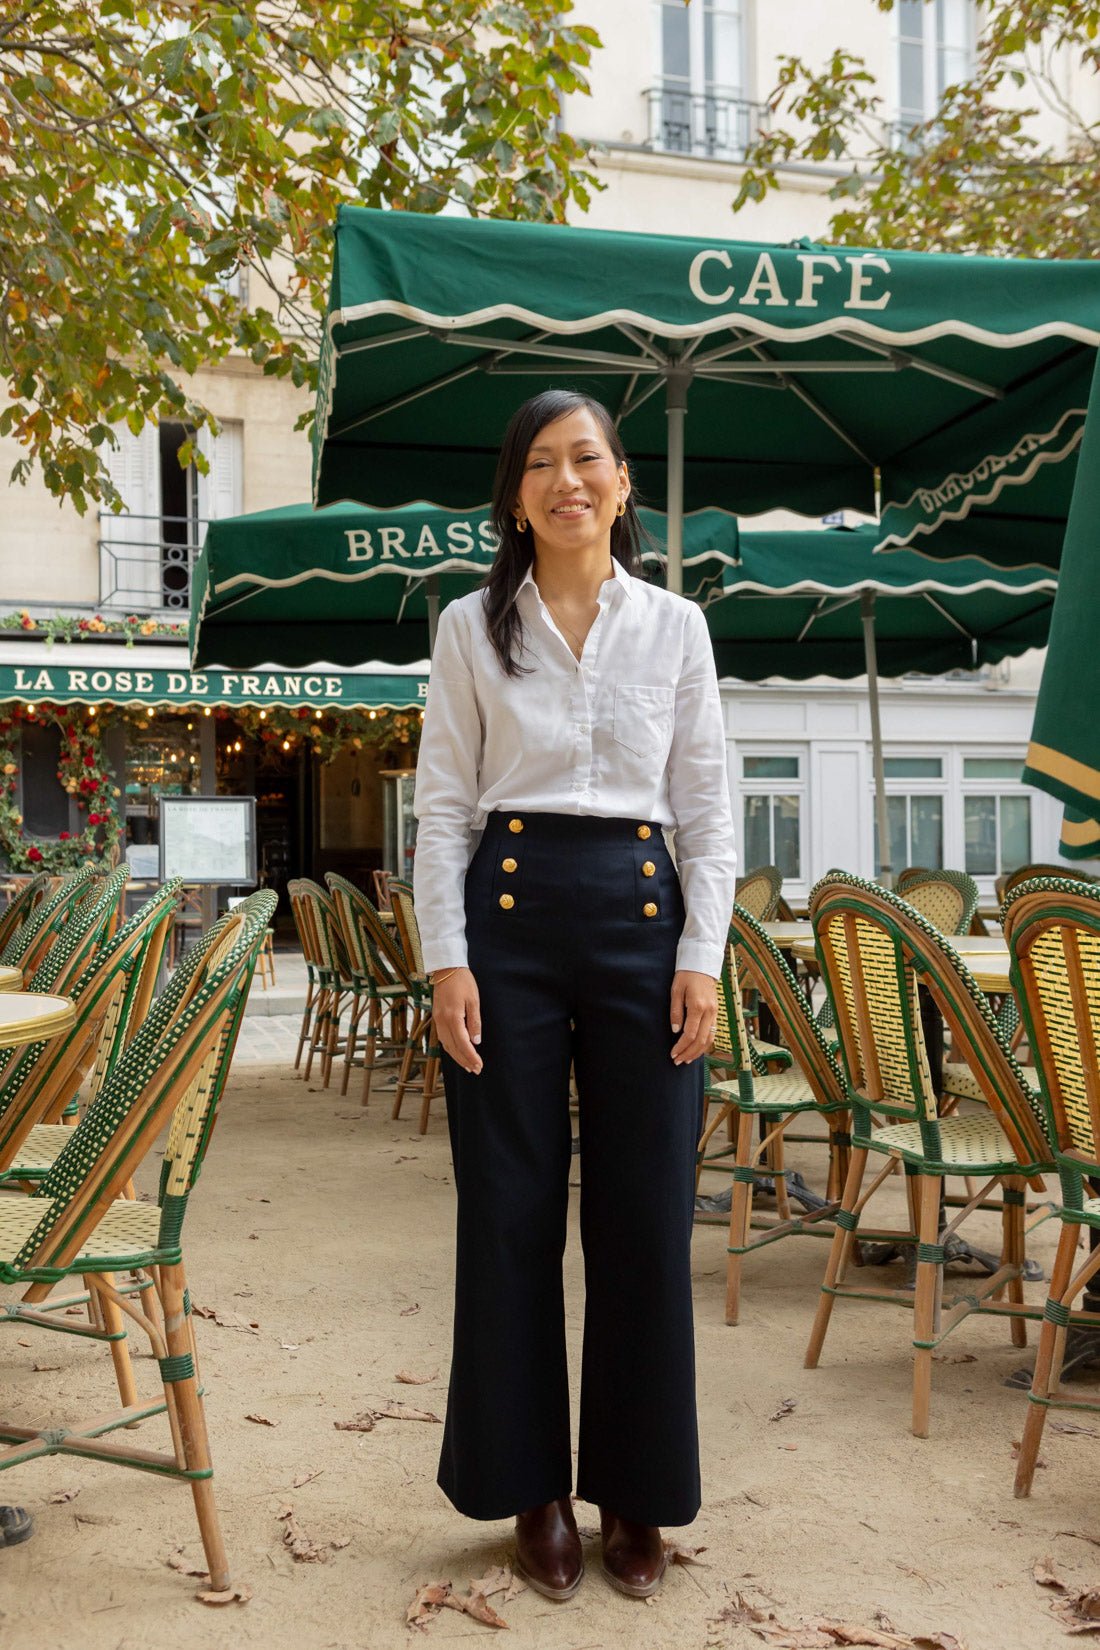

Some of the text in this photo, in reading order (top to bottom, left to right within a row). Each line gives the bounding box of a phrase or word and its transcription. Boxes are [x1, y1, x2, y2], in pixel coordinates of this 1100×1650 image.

[689, 250, 892, 310] CAFÉ
[344, 521, 501, 562] BRASS
[14, 669, 343, 697] LA ROSE DE FRANCE
